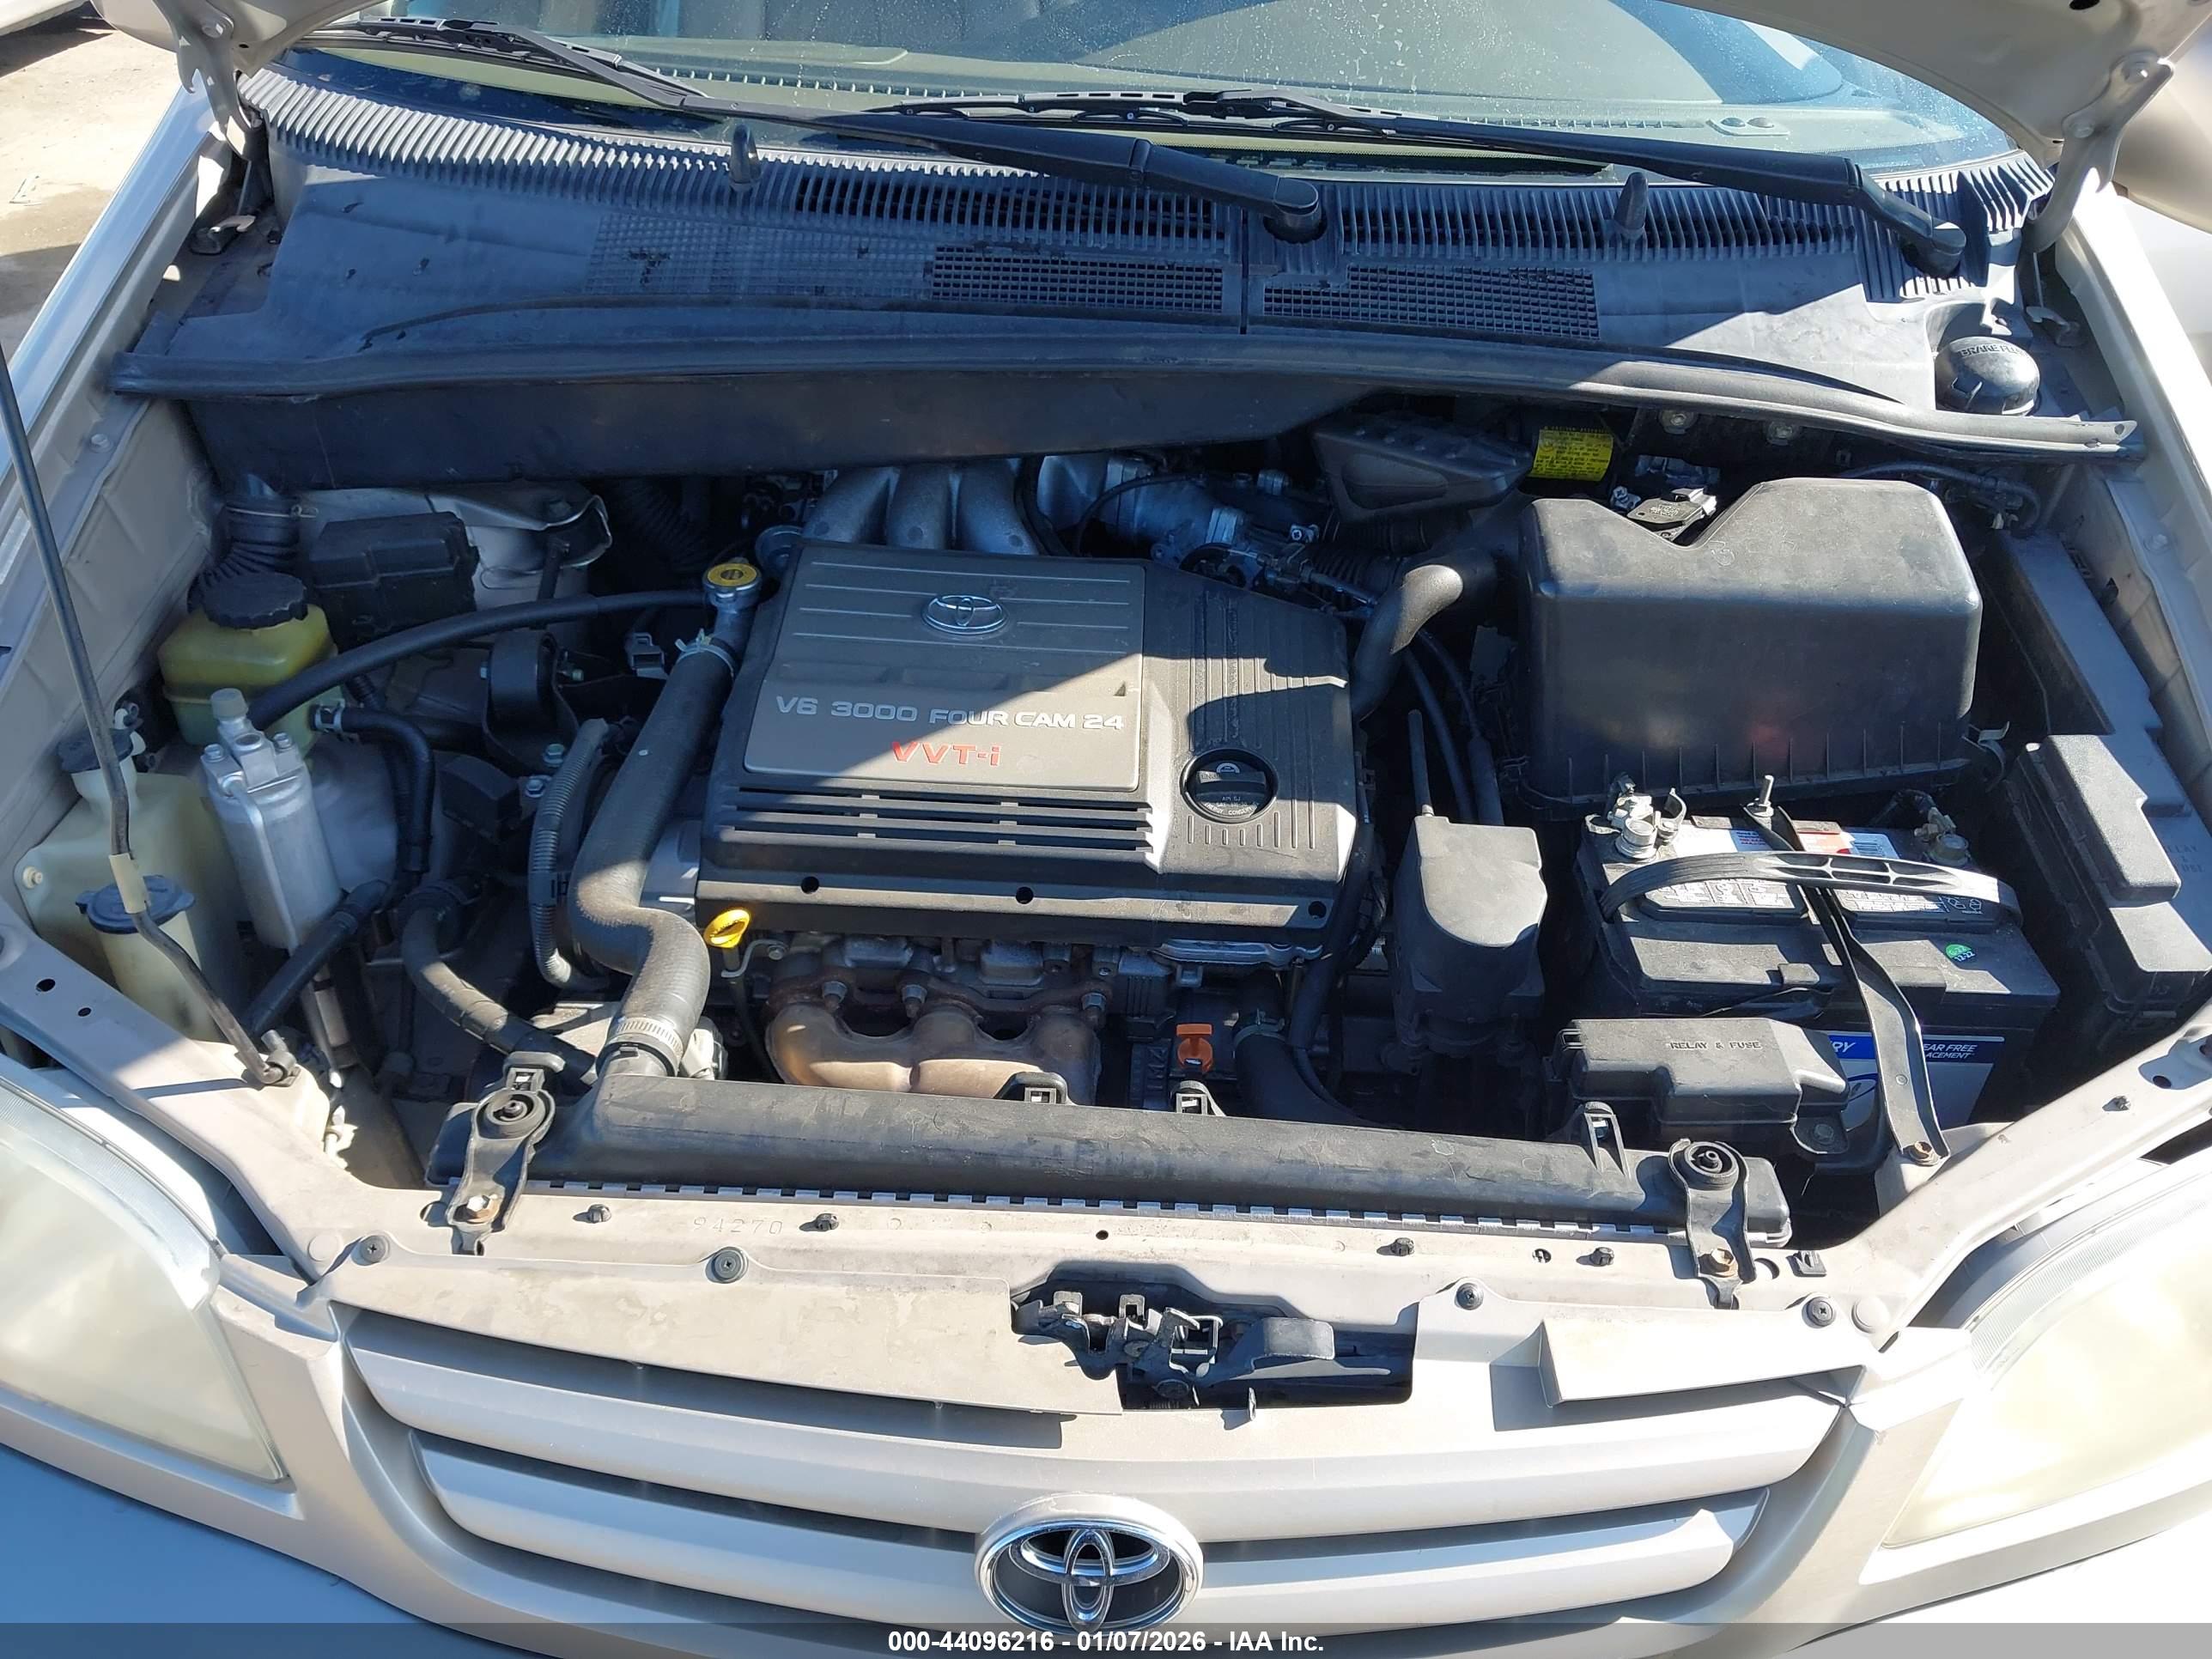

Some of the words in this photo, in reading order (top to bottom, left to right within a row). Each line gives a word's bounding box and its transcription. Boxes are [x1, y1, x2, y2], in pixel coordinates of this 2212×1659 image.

[1960, 344, 1999, 356] BRAKE
[776, 696, 818, 715] V6
[830, 701, 917, 722] 3000
[929, 708, 1010, 727] FOUR
[1013, 711, 1077, 729] CAM
[1083, 714, 1125, 730] 24
[891, 741, 1002, 767] VVT-i
[1945, 1044, 1978, 1053] FREE
